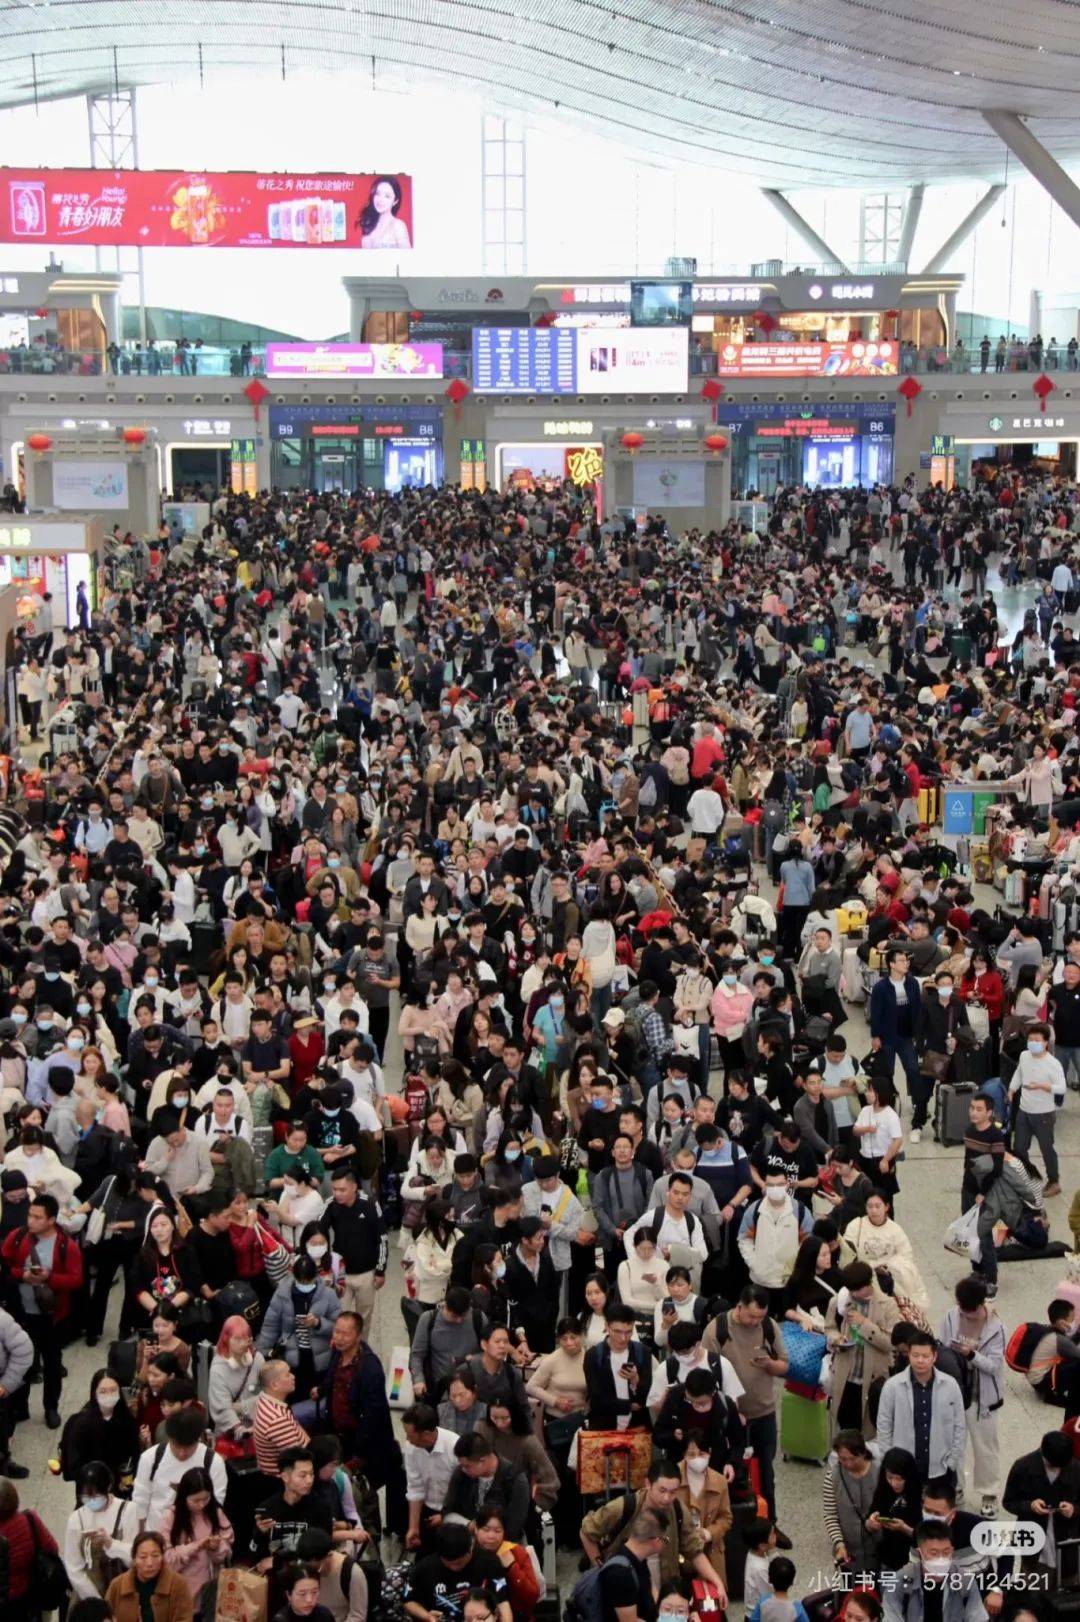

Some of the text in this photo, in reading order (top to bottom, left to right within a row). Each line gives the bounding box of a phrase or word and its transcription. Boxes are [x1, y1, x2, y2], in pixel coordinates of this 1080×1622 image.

[59, 206, 125, 228] 青春好朋友
[870, 421, 884, 432] B6
[1012, 418, 1065, 428] 星巴克咖啡
[278, 425, 293, 435] B9
[419, 425, 434, 435] B8
[728, 423, 742, 434] B7
